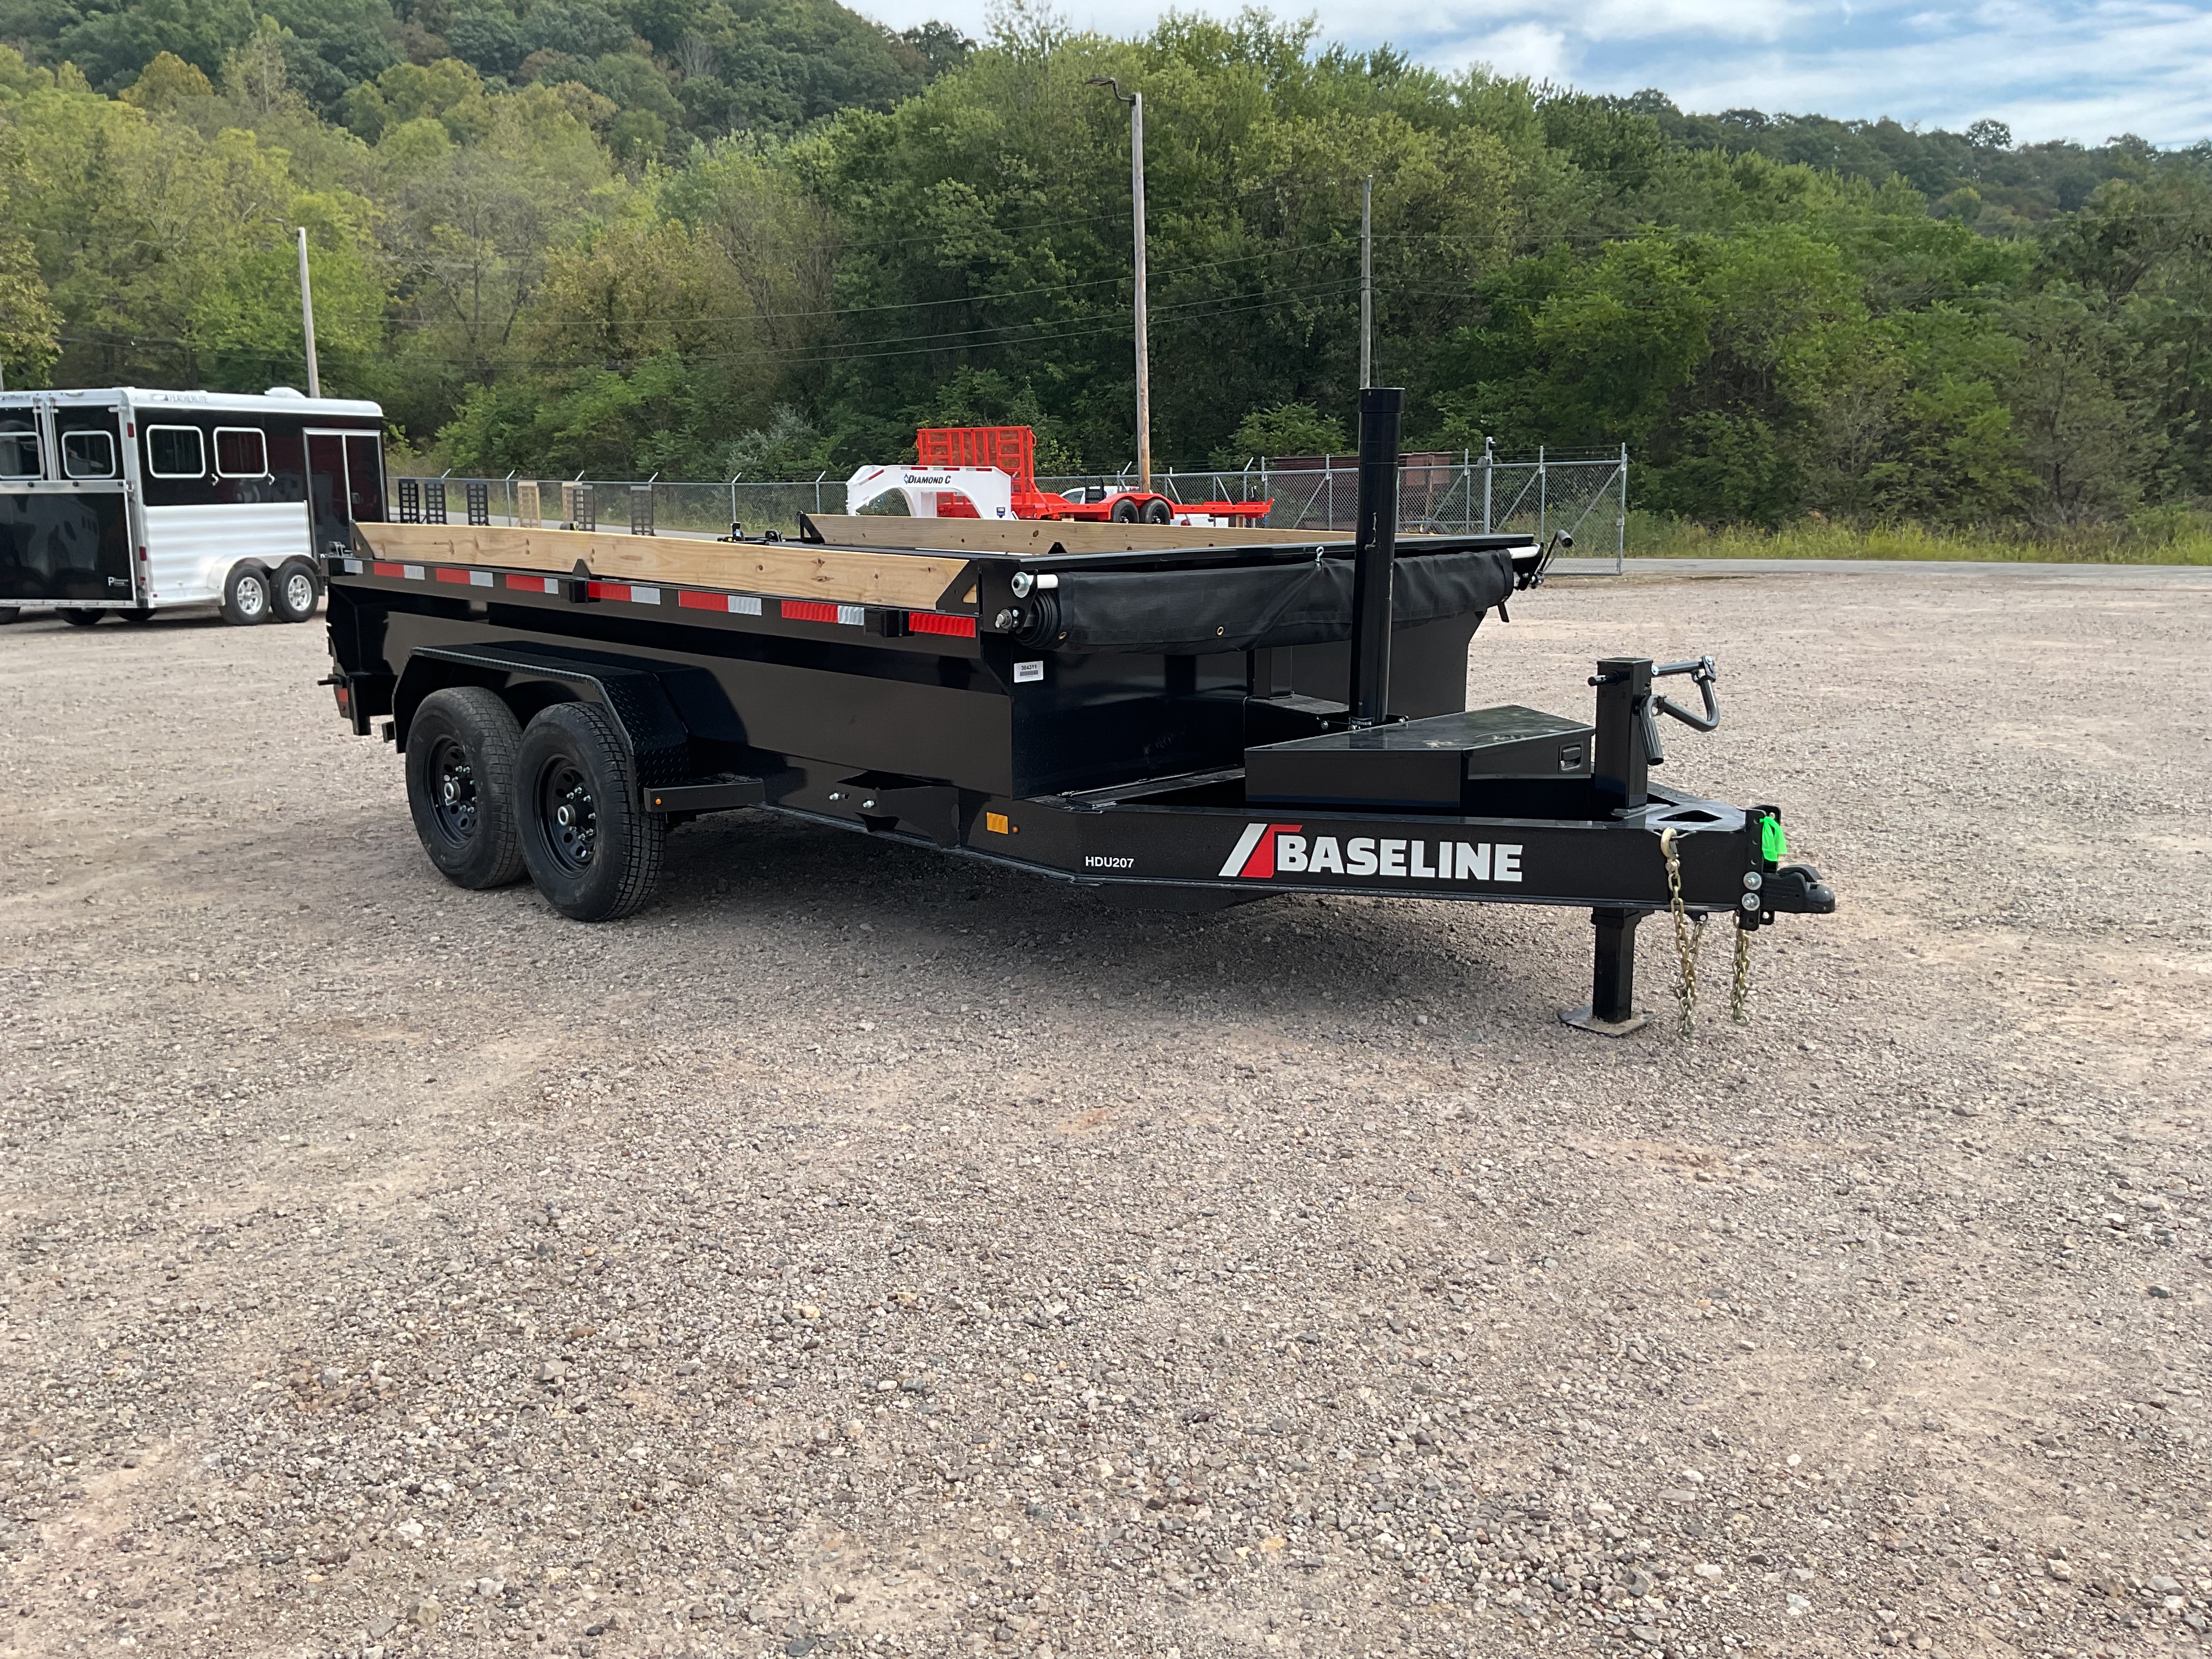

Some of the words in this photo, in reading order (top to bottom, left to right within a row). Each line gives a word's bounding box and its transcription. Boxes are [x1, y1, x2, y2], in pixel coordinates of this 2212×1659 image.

[908, 475, 944, 484] DIAMOND
[944, 475, 951, 484] C
[1085, 856, 1135, 868] HDU207
[1277, 834, 1523, 882] BASELINE
